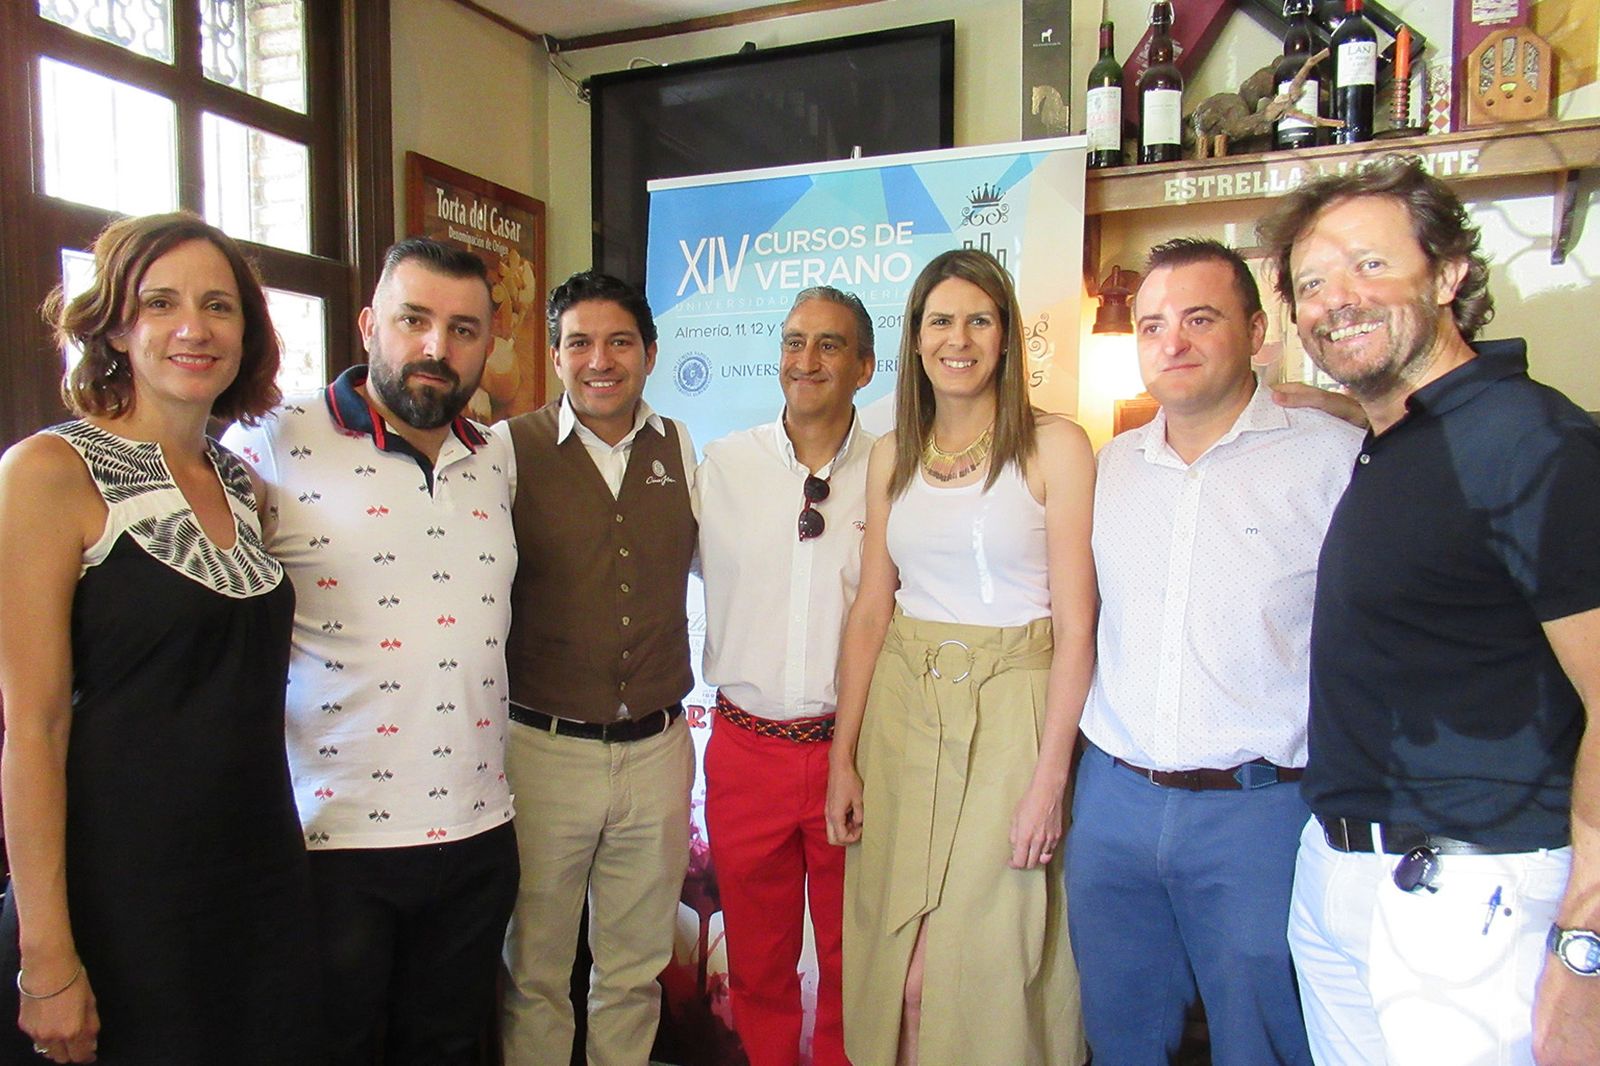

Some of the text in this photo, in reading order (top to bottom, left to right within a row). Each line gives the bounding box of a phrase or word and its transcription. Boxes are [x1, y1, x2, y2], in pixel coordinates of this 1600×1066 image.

[1347, 44, 1372, 56] LAN
[1163, 166, 1302, 201] ESTRELLA
[436, 188, 522, 243] Torta del Casar
[485, 237, 492, 251] de
[754, 221, 914, 256] CURSOS DE
[675, 233, 750, 297] XIV
[754, 251, 913, 291] VERANO
[675, 295, 789, 312] UNIVERSIDAD
[750, 322, 764, 335] 12
[766, 324, 776, 337] y
[876, 314, 905, 329] 201
[721, 363, 781, 378] UNIVERS
